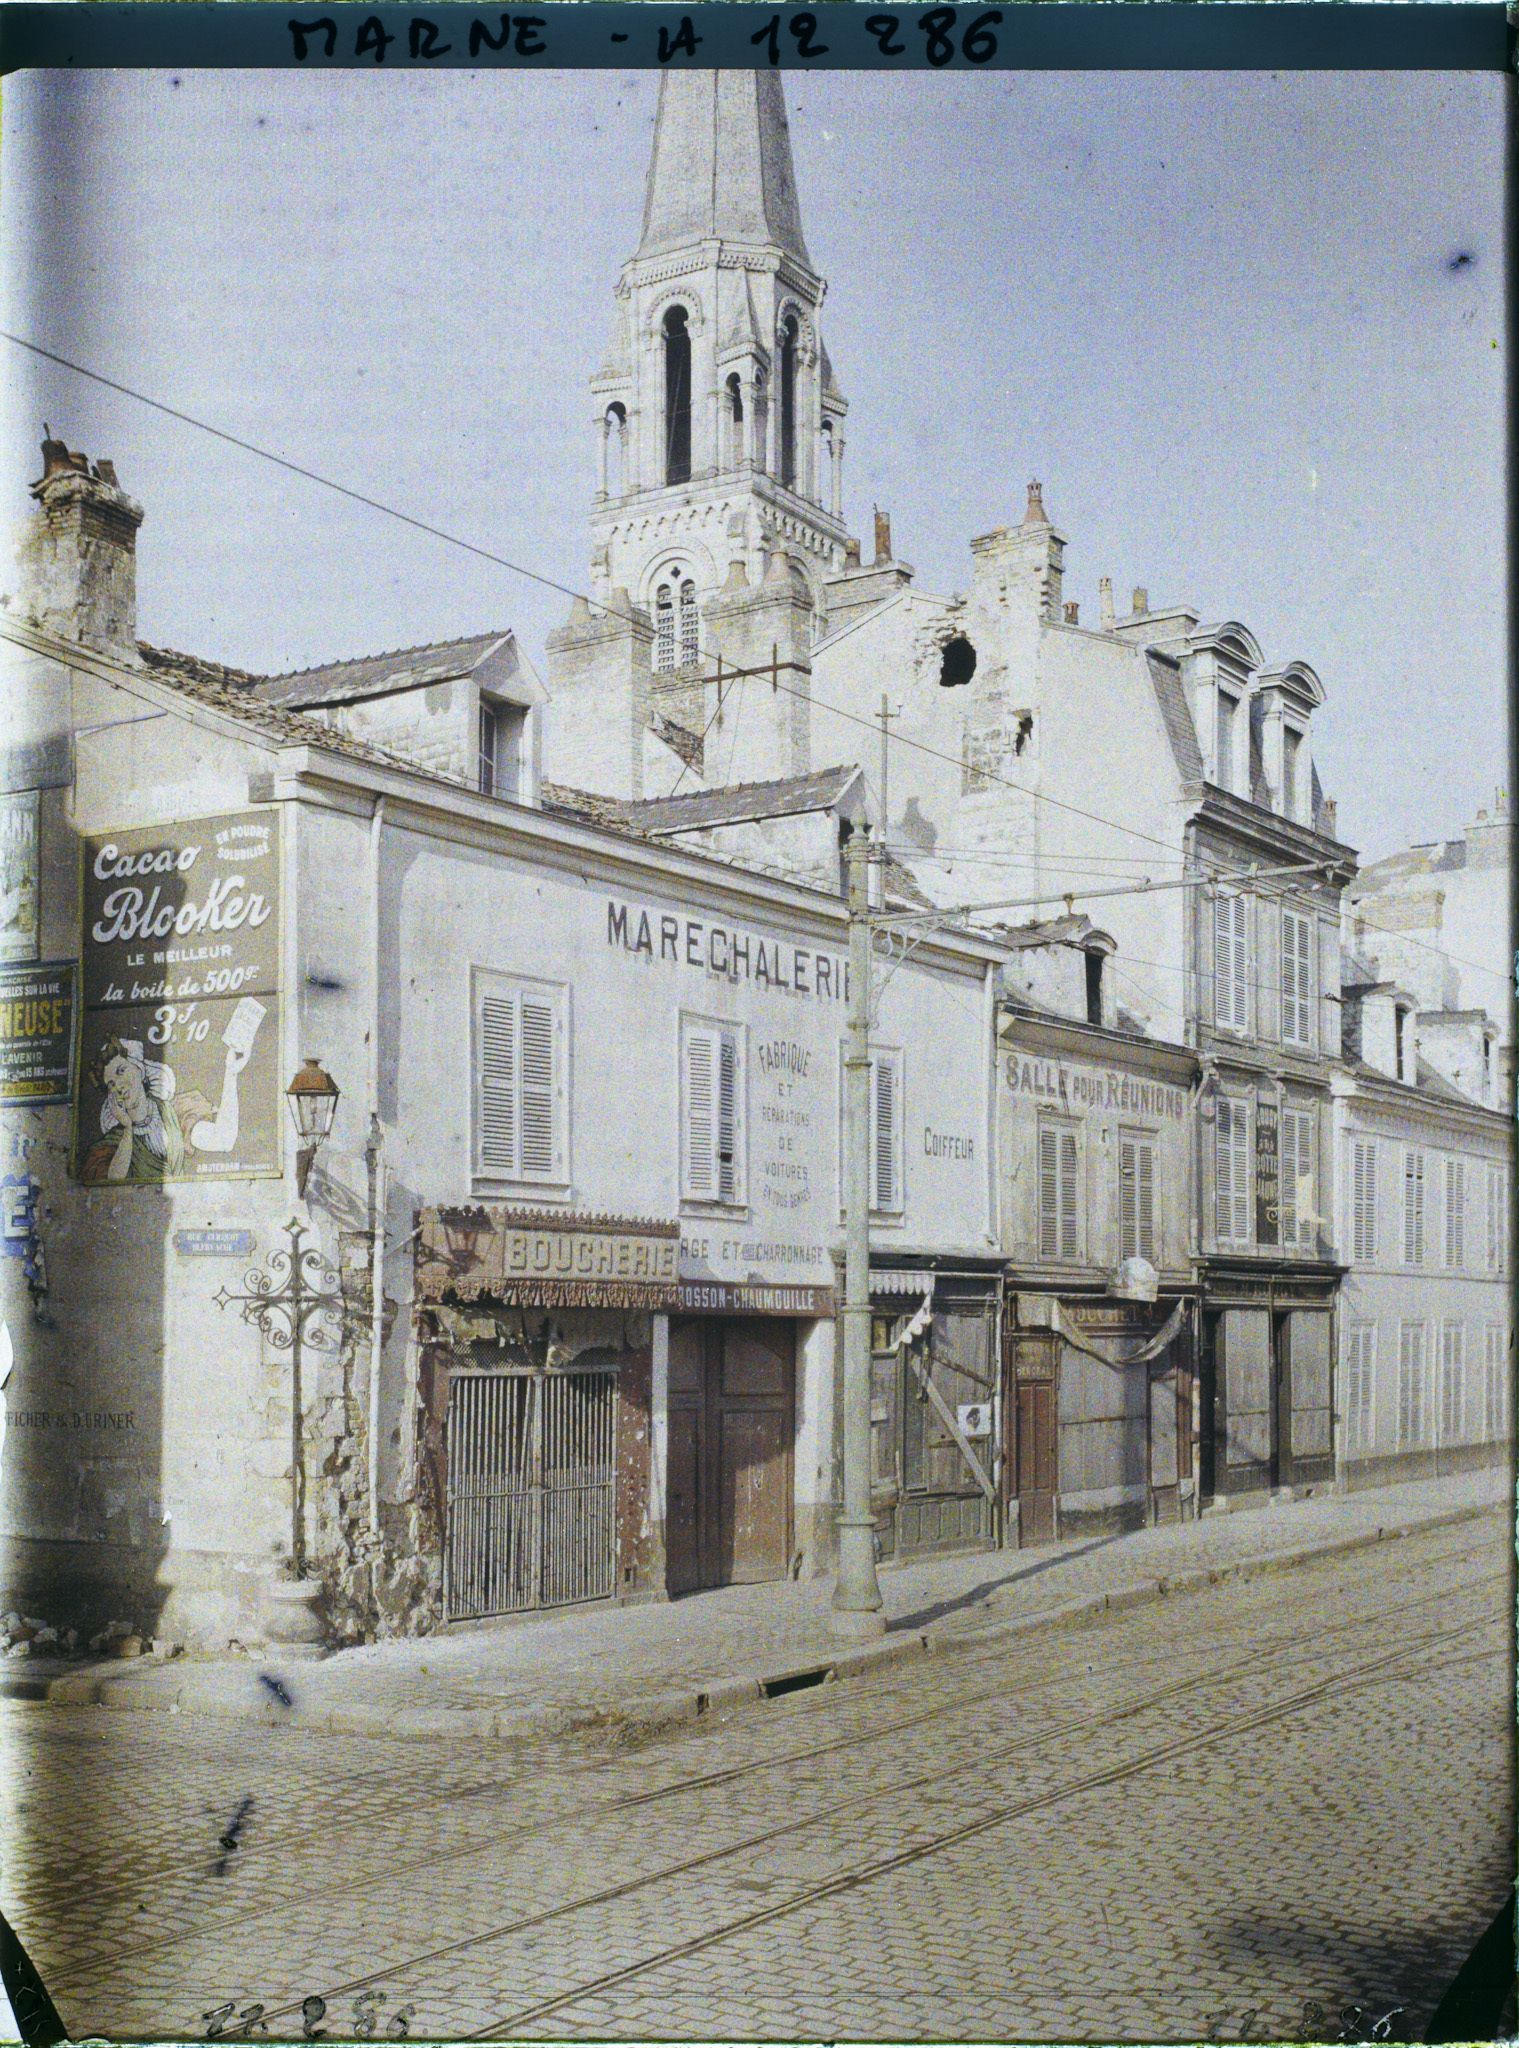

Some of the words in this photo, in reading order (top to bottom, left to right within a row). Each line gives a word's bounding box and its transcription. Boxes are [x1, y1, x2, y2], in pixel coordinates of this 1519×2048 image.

[94, 844, 202, 881] Cacao
[127, 953, 145, 966] LE
[153, 944, 233, 965] MEILLEUR
[39, 983, 47, 995] LA
[48, 982, 60, 994] VIE
[101, 983, 126, 1002] la
[177, 976, 201, 996] de
[758, 1040, 812, 1078] FABRIQUE
[778, 1082, 793, 1097] ET
[1006, 1054, 1069, 1099] SALLE
[1073, 1075, 1104, 1105] POUR
[778, 1136, 793, 1151] DE
[923, 1126, 975, 1161] COIFFEUR
[765, 1162, 808, 1181] VOITURES
[509, 1236, 675, 1277] BOUCHERIE
[722, 1240, 741, 1260] ET
[756, 1242, 824, 1265] CHARRONNAGE
